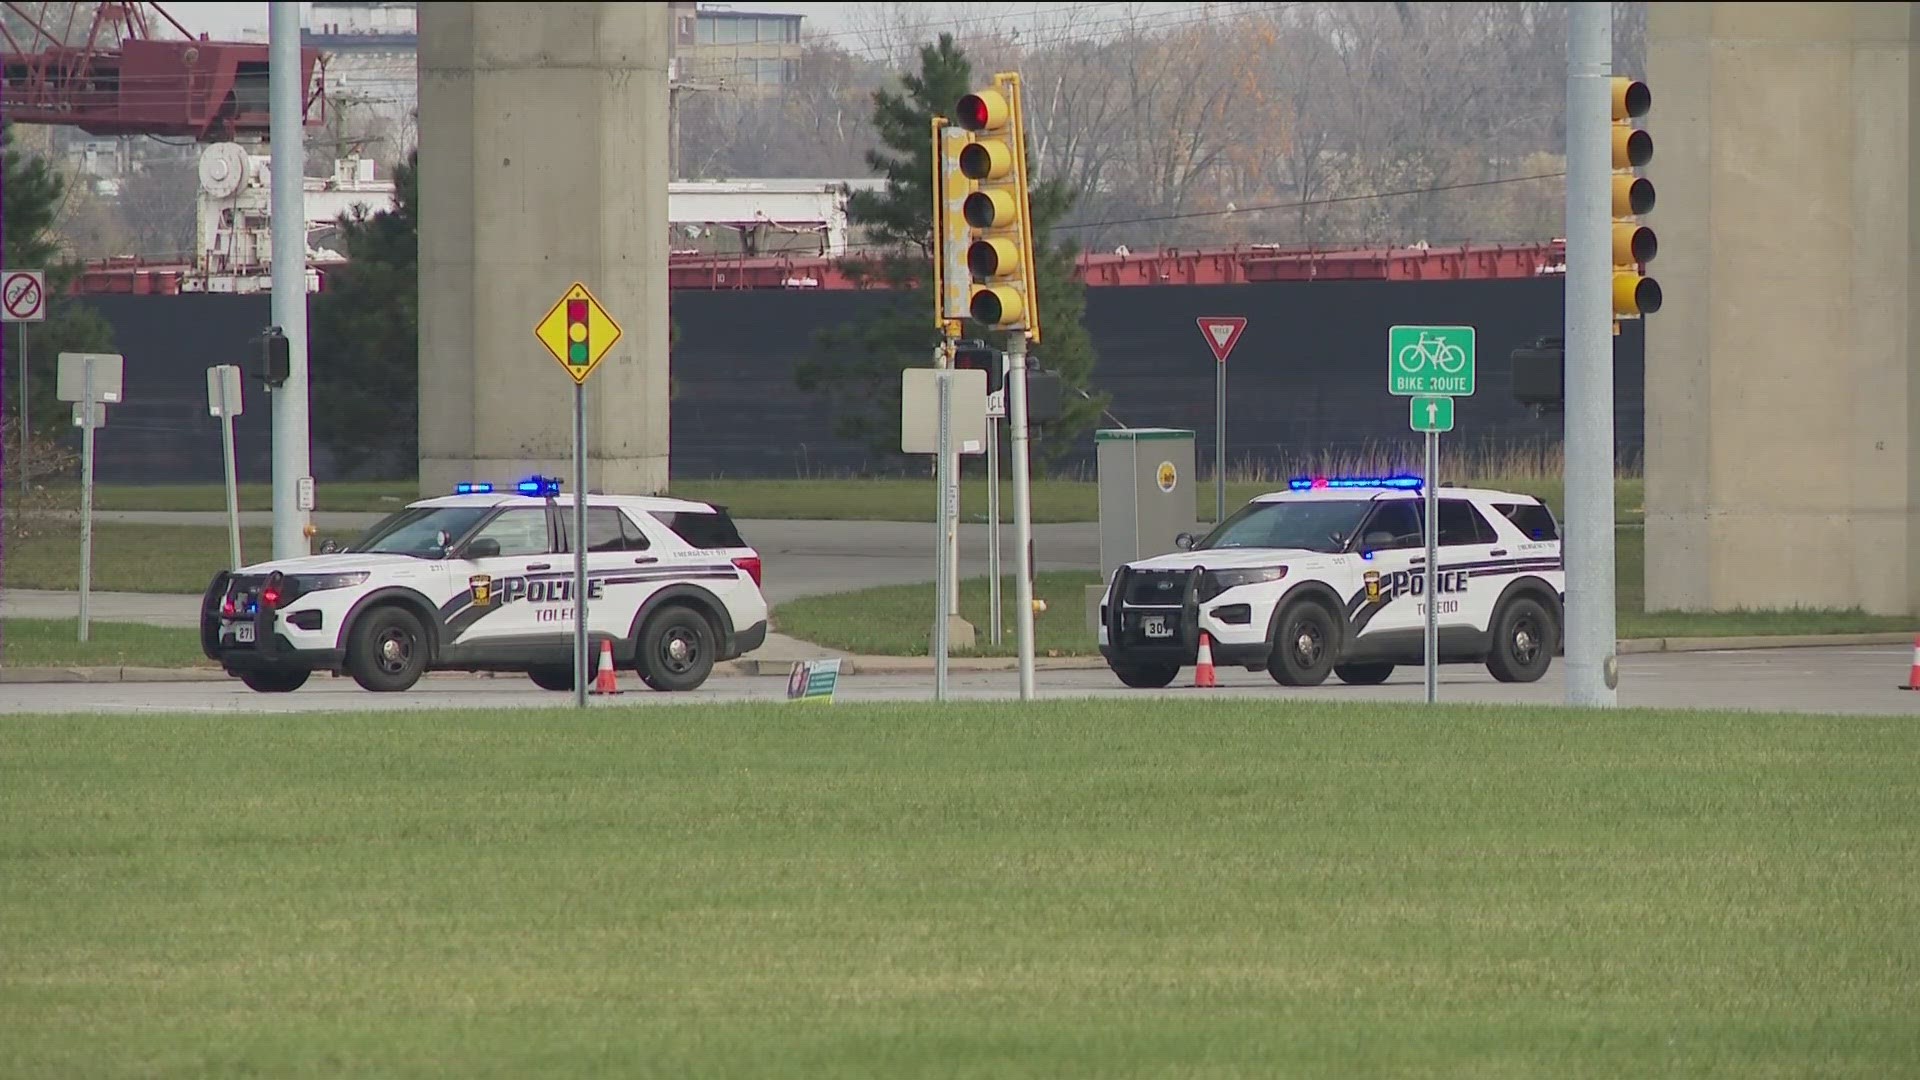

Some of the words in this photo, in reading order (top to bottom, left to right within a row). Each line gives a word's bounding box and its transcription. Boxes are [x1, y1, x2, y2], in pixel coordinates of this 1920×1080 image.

[1397, 377, 1424, 390] BIKE
[1430, 377, 1467, 390] ROUTE
[502, 576, 605, 605] POLIE
[1392, 571, 1468, 600] POICE
[1416, 600, 1459, 617] TEDO
[239, 627, 253, 640] 271
